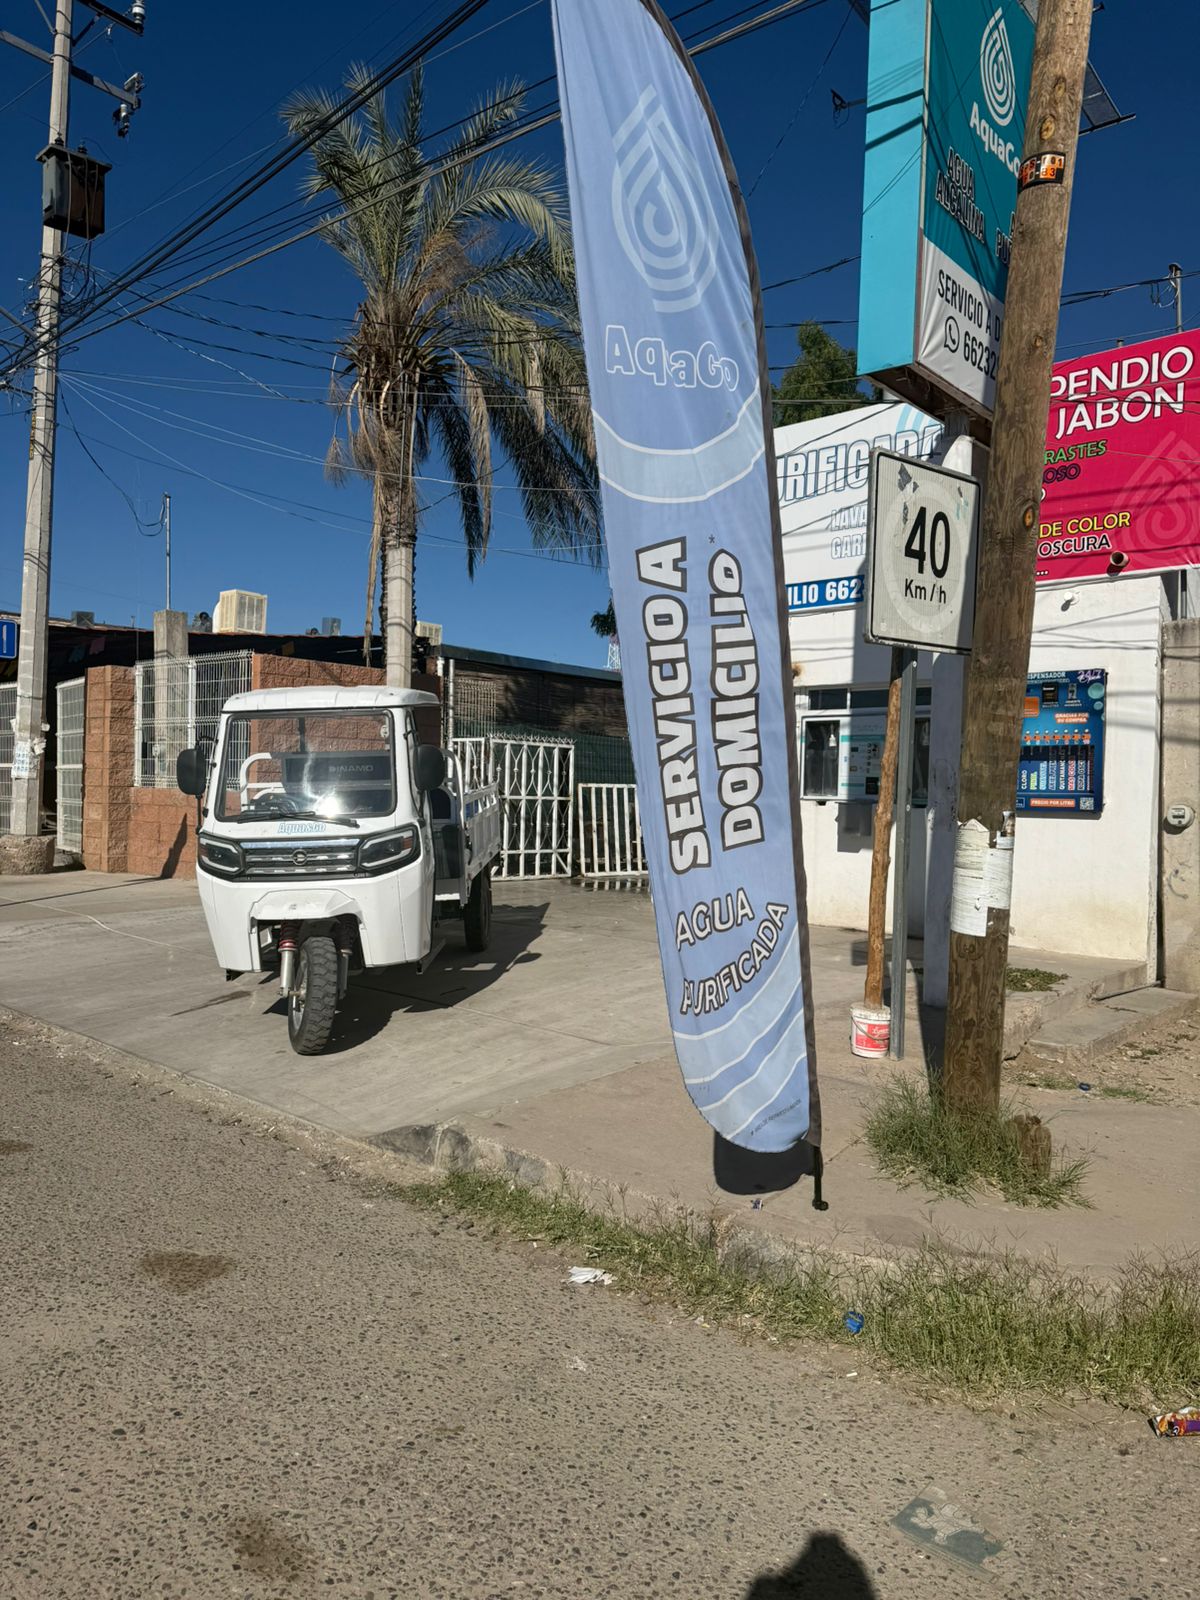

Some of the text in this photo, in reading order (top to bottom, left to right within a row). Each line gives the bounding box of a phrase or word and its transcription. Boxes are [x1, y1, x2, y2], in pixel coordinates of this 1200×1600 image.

[947, 145, 975, 201] AGUA
[935, 169, 985, 243] ALCALINA
[937, 268, 984, 329] SERVICIO
[985, 308, 992, 336] A
[963, 330, 999, 380] 66232
[1054, 381, 1186, 441] JABON
[1043, 439, 1107, 466] RASTES
[904, 505, 951, 579] 40
[1038, 533, 1112, 558] OSCURA
[1039, 511, 1132, 539] DE COLOR
[904, 578, 948, 604] Km/h
[634, 535, 711, 875] SERVICIO A
[708, 548, 765, 852] DOMICILIO
[676, 887, 756, 952] AGUA
